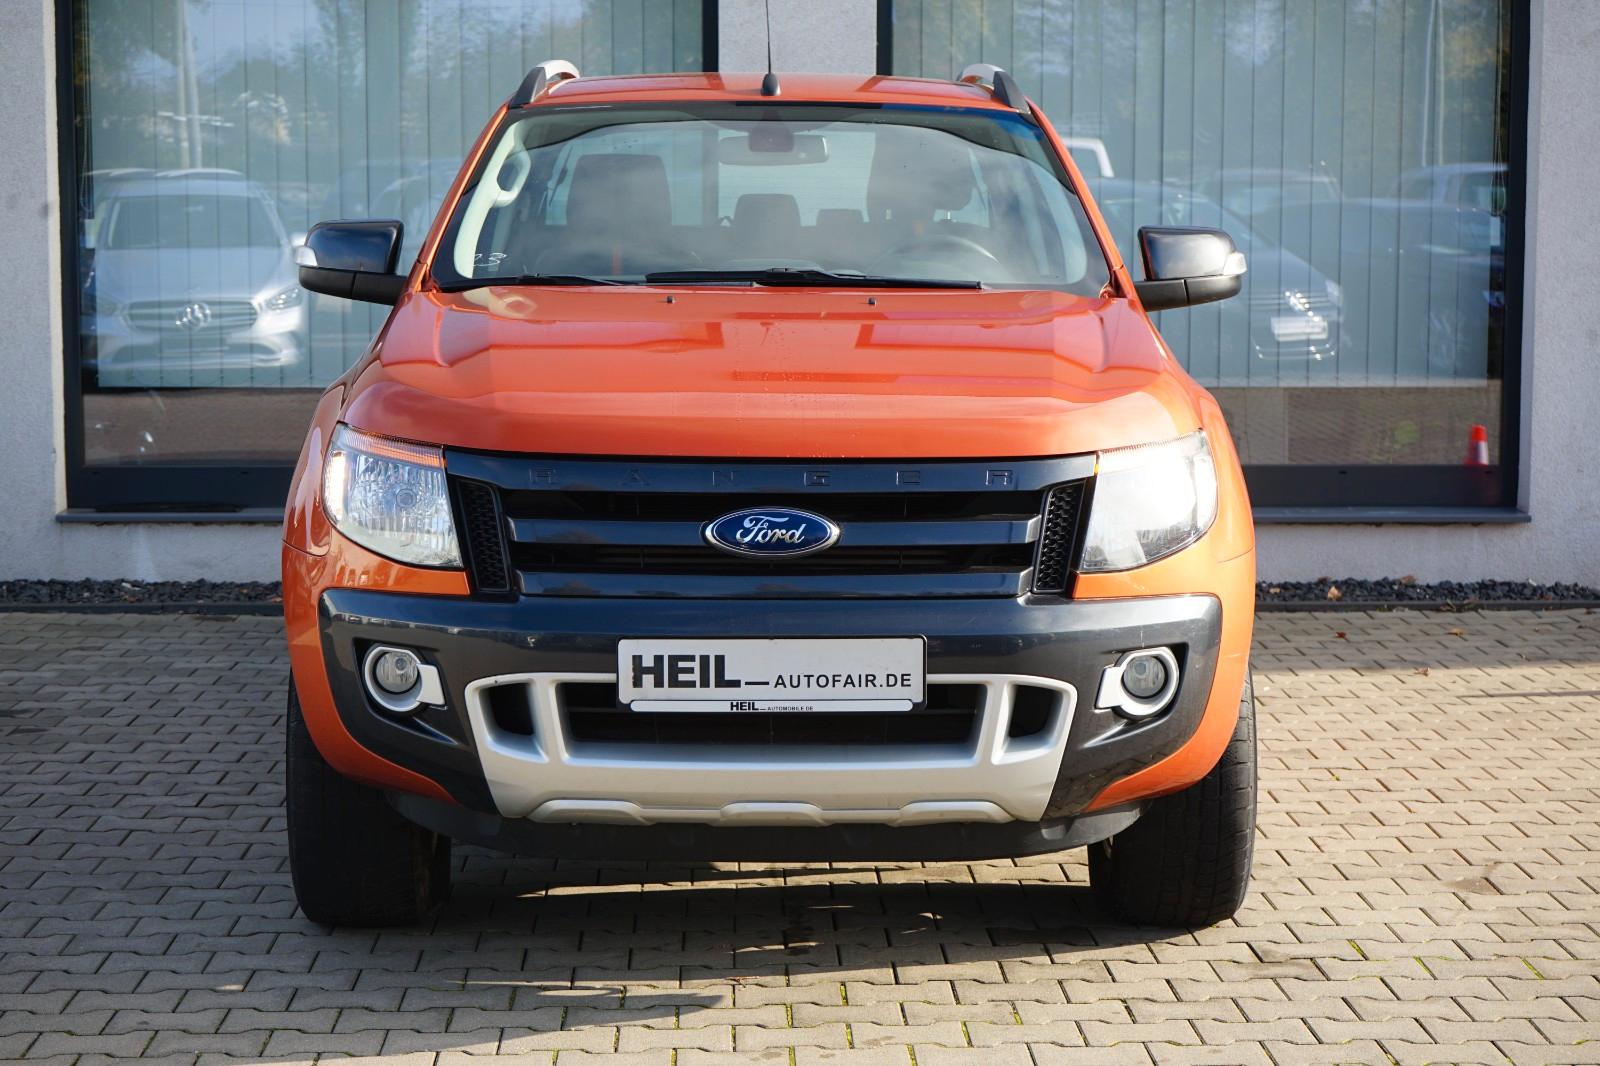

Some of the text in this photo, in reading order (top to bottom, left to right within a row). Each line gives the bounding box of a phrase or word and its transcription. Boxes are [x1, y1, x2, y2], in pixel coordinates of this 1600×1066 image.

[528, 468, 1013, 487] RANGER
[736, 515, 806, 544] Ford
[774, 673, 912, 688] AUTOFAIR.DE
